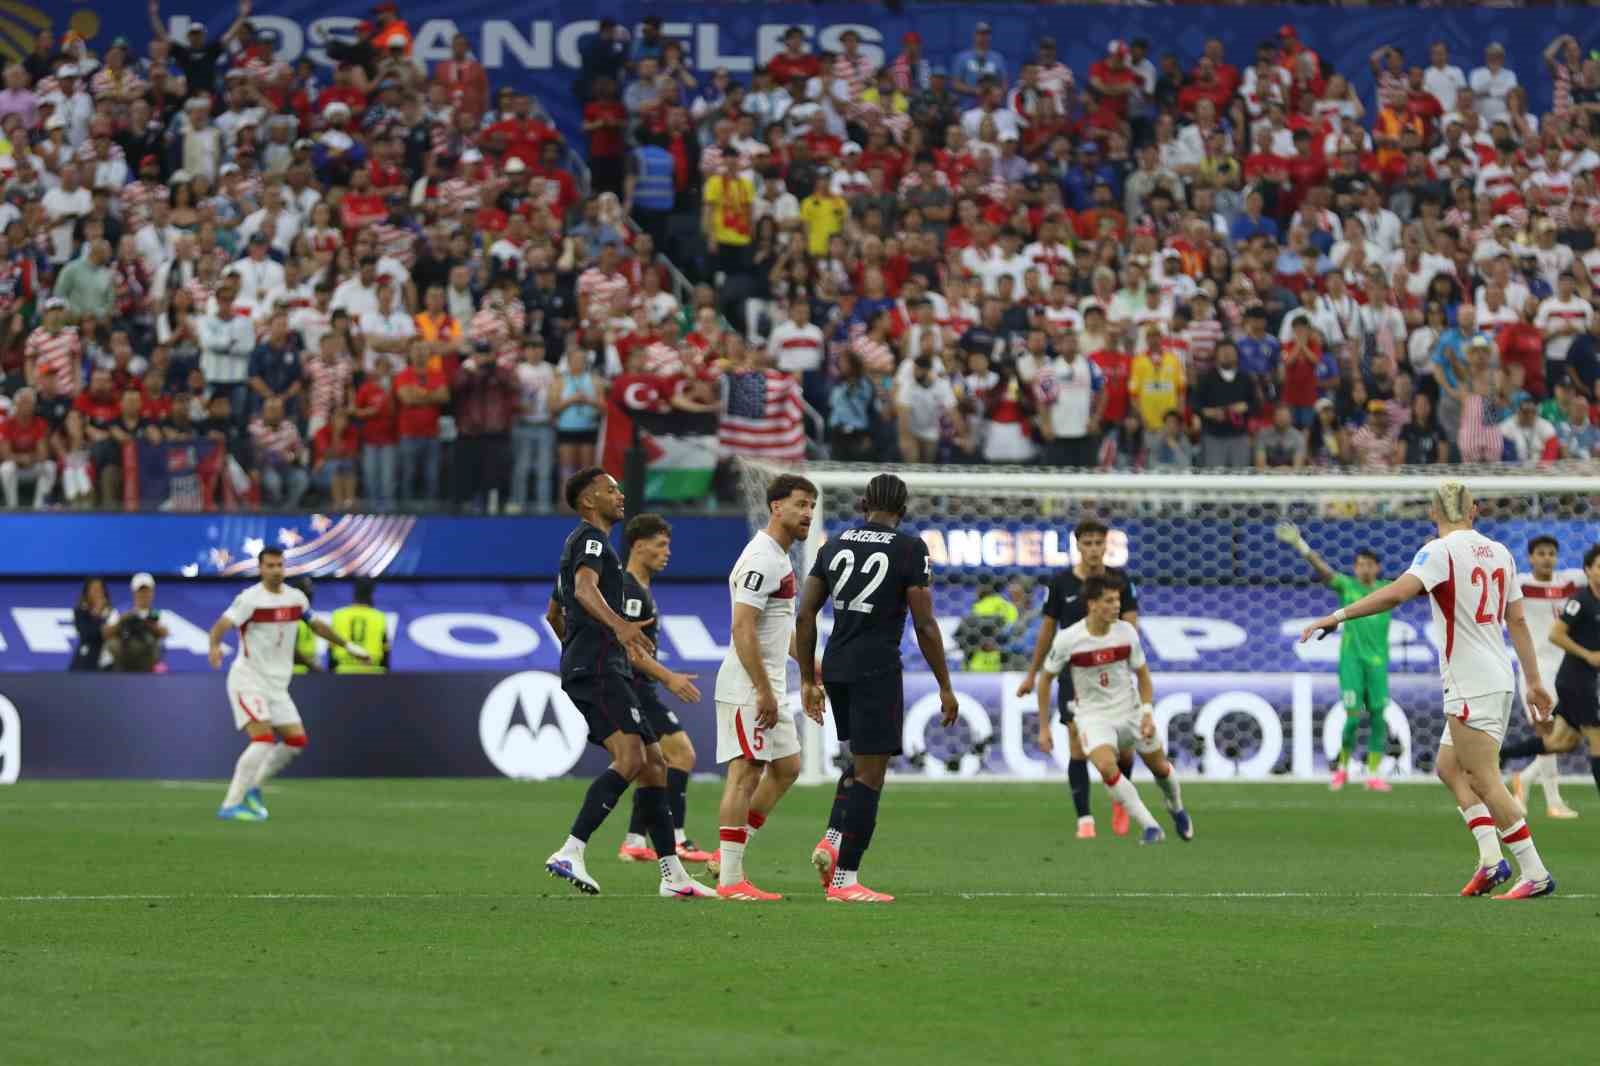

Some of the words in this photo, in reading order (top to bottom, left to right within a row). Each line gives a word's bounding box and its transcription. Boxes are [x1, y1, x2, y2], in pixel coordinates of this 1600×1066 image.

[828, 548, 889, 614] 22
[1471, 566, 1506, 625] 21
[753, 727, 765, 752] 5
